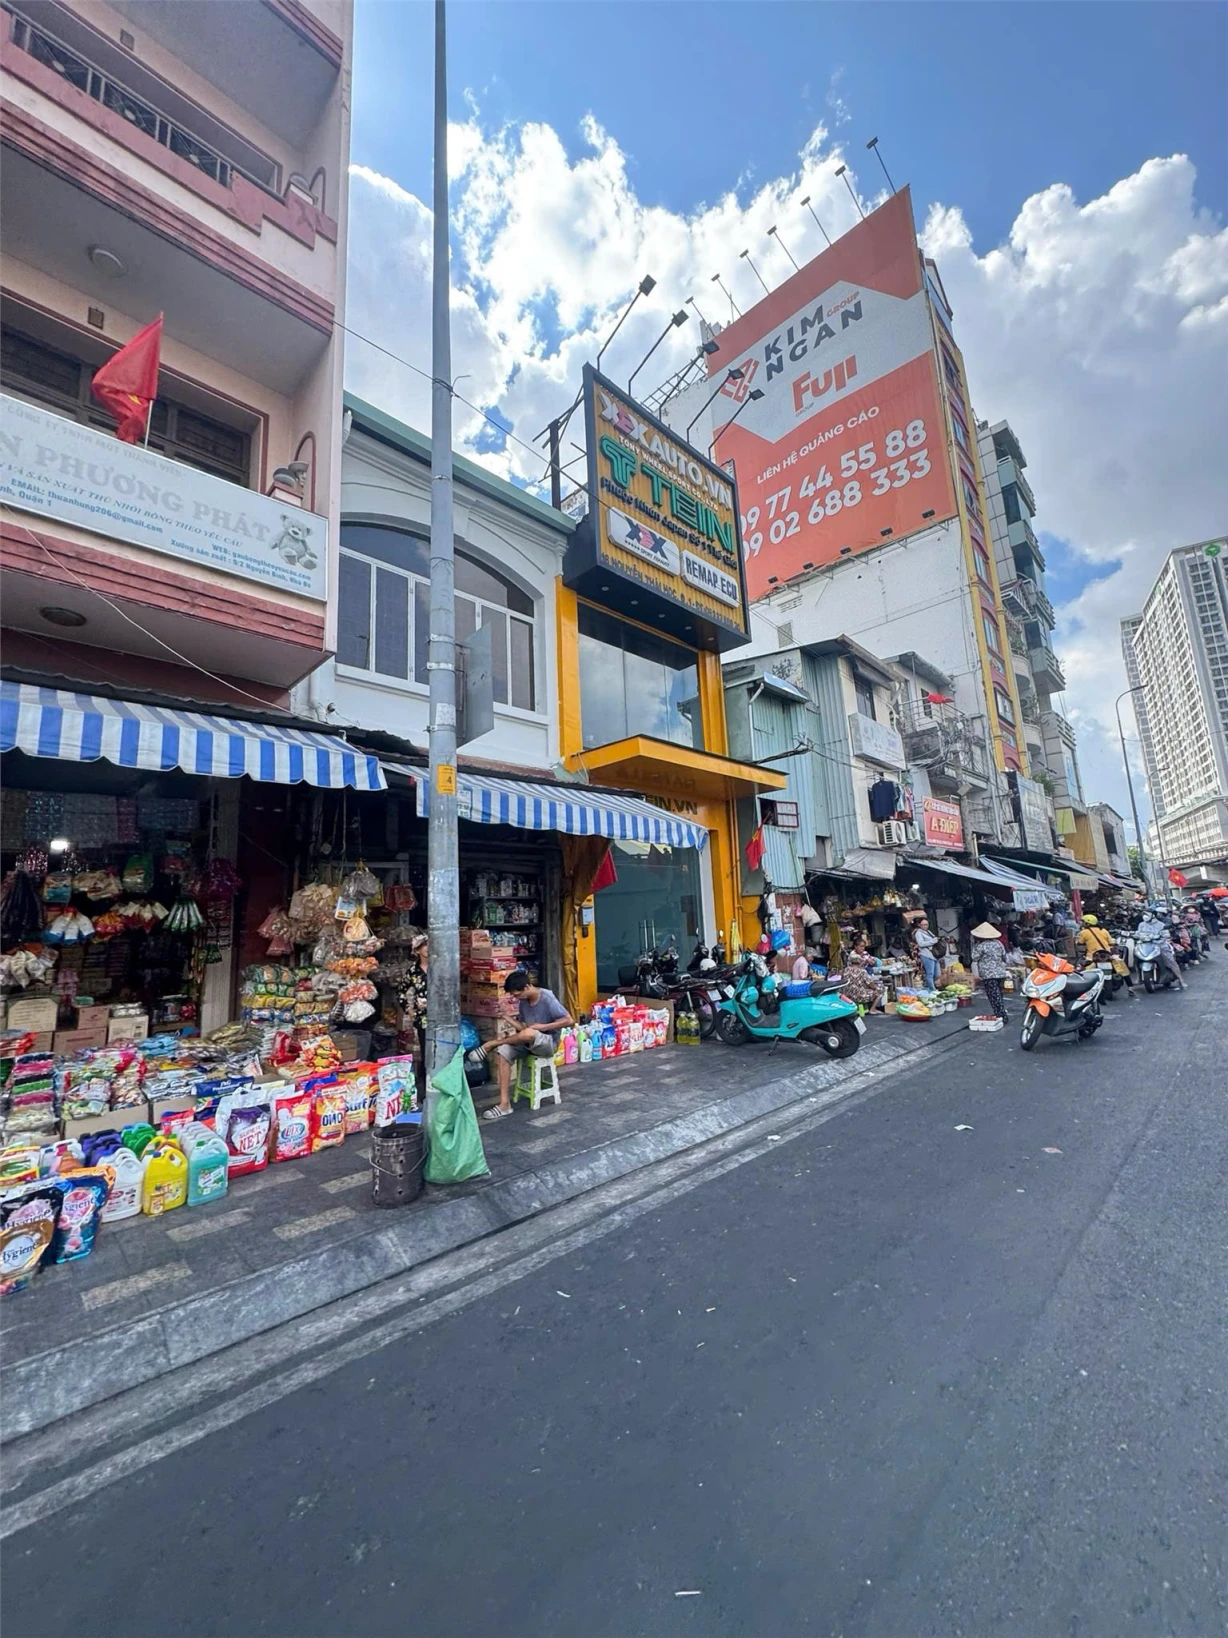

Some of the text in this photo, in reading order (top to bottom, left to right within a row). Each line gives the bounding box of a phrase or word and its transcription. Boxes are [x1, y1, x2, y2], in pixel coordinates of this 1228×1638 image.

[765, 291, 860, 363] KIM GROUP
[619, 435, 640, 455] TONY
[642, 452, 667, 475] WHEEL
[669, 471, 690, 492] SPORT
[757, 406, 880, 485] LIÊN HỆ QUẢNG CÁO
[765, 486, 792, 519] 77
[799, 465, 833, 499] 44
[841, 442, 877, 478] 55
[885, 419, 927, 458] 88
[11, 478, 45, 495] EMAIL:
[35, 444, 184, 512] PHƯƠNG
[193, 500, 270, 542] PHÁT
[641, 463, 733, 554] TEIN
[769, 511, 801, 545] 02
[807, 481, 862, 525] 688
[870, 448, 931, 496] 333
[685, 557, 737, 601] REMAP ECU
[322, 1112, 343, 1127] OMO
